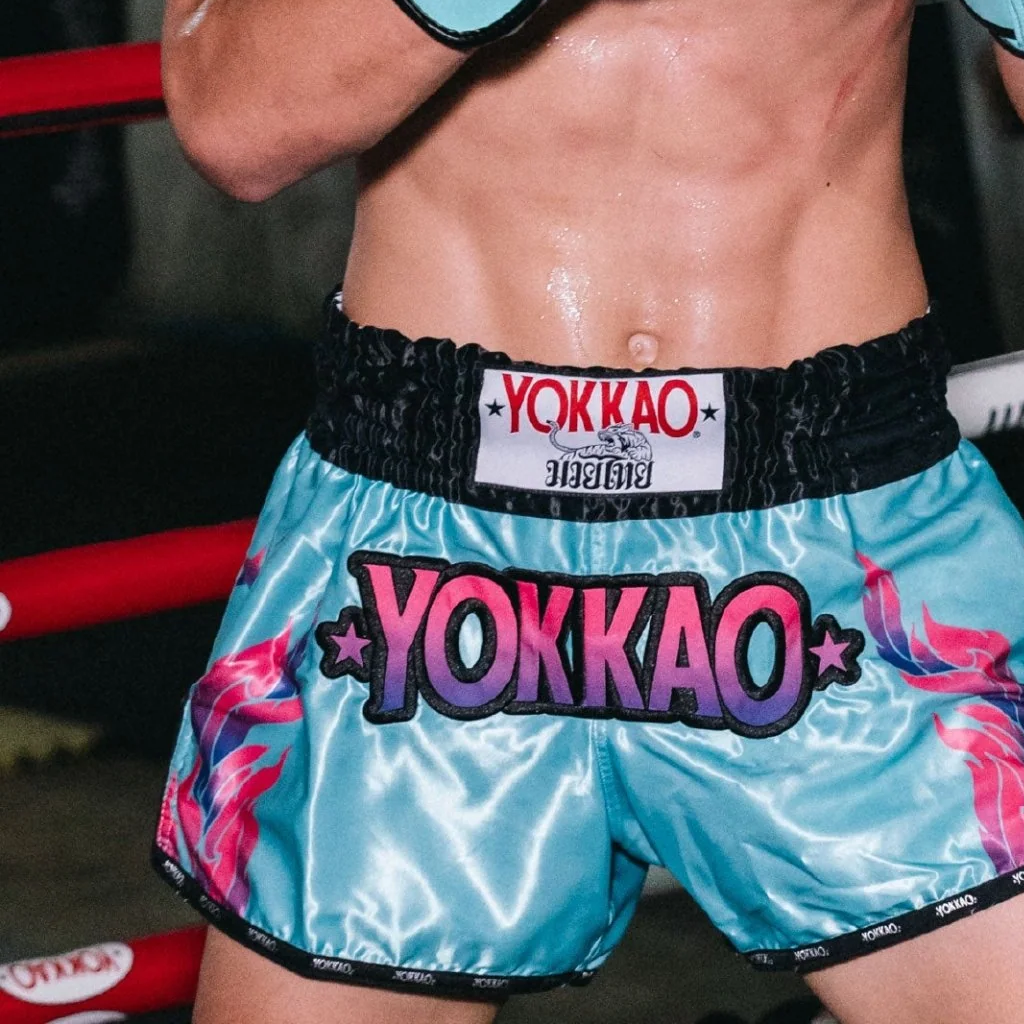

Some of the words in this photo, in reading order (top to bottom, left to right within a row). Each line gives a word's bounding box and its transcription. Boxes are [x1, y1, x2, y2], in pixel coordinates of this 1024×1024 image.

[502, 373, 698, 438] YOKKAO
[362, 564, 804, 726] YOKKAO
[936, 894, 975, 917] YOKKAO
[861, 923, 899, 942] YOKKAO
